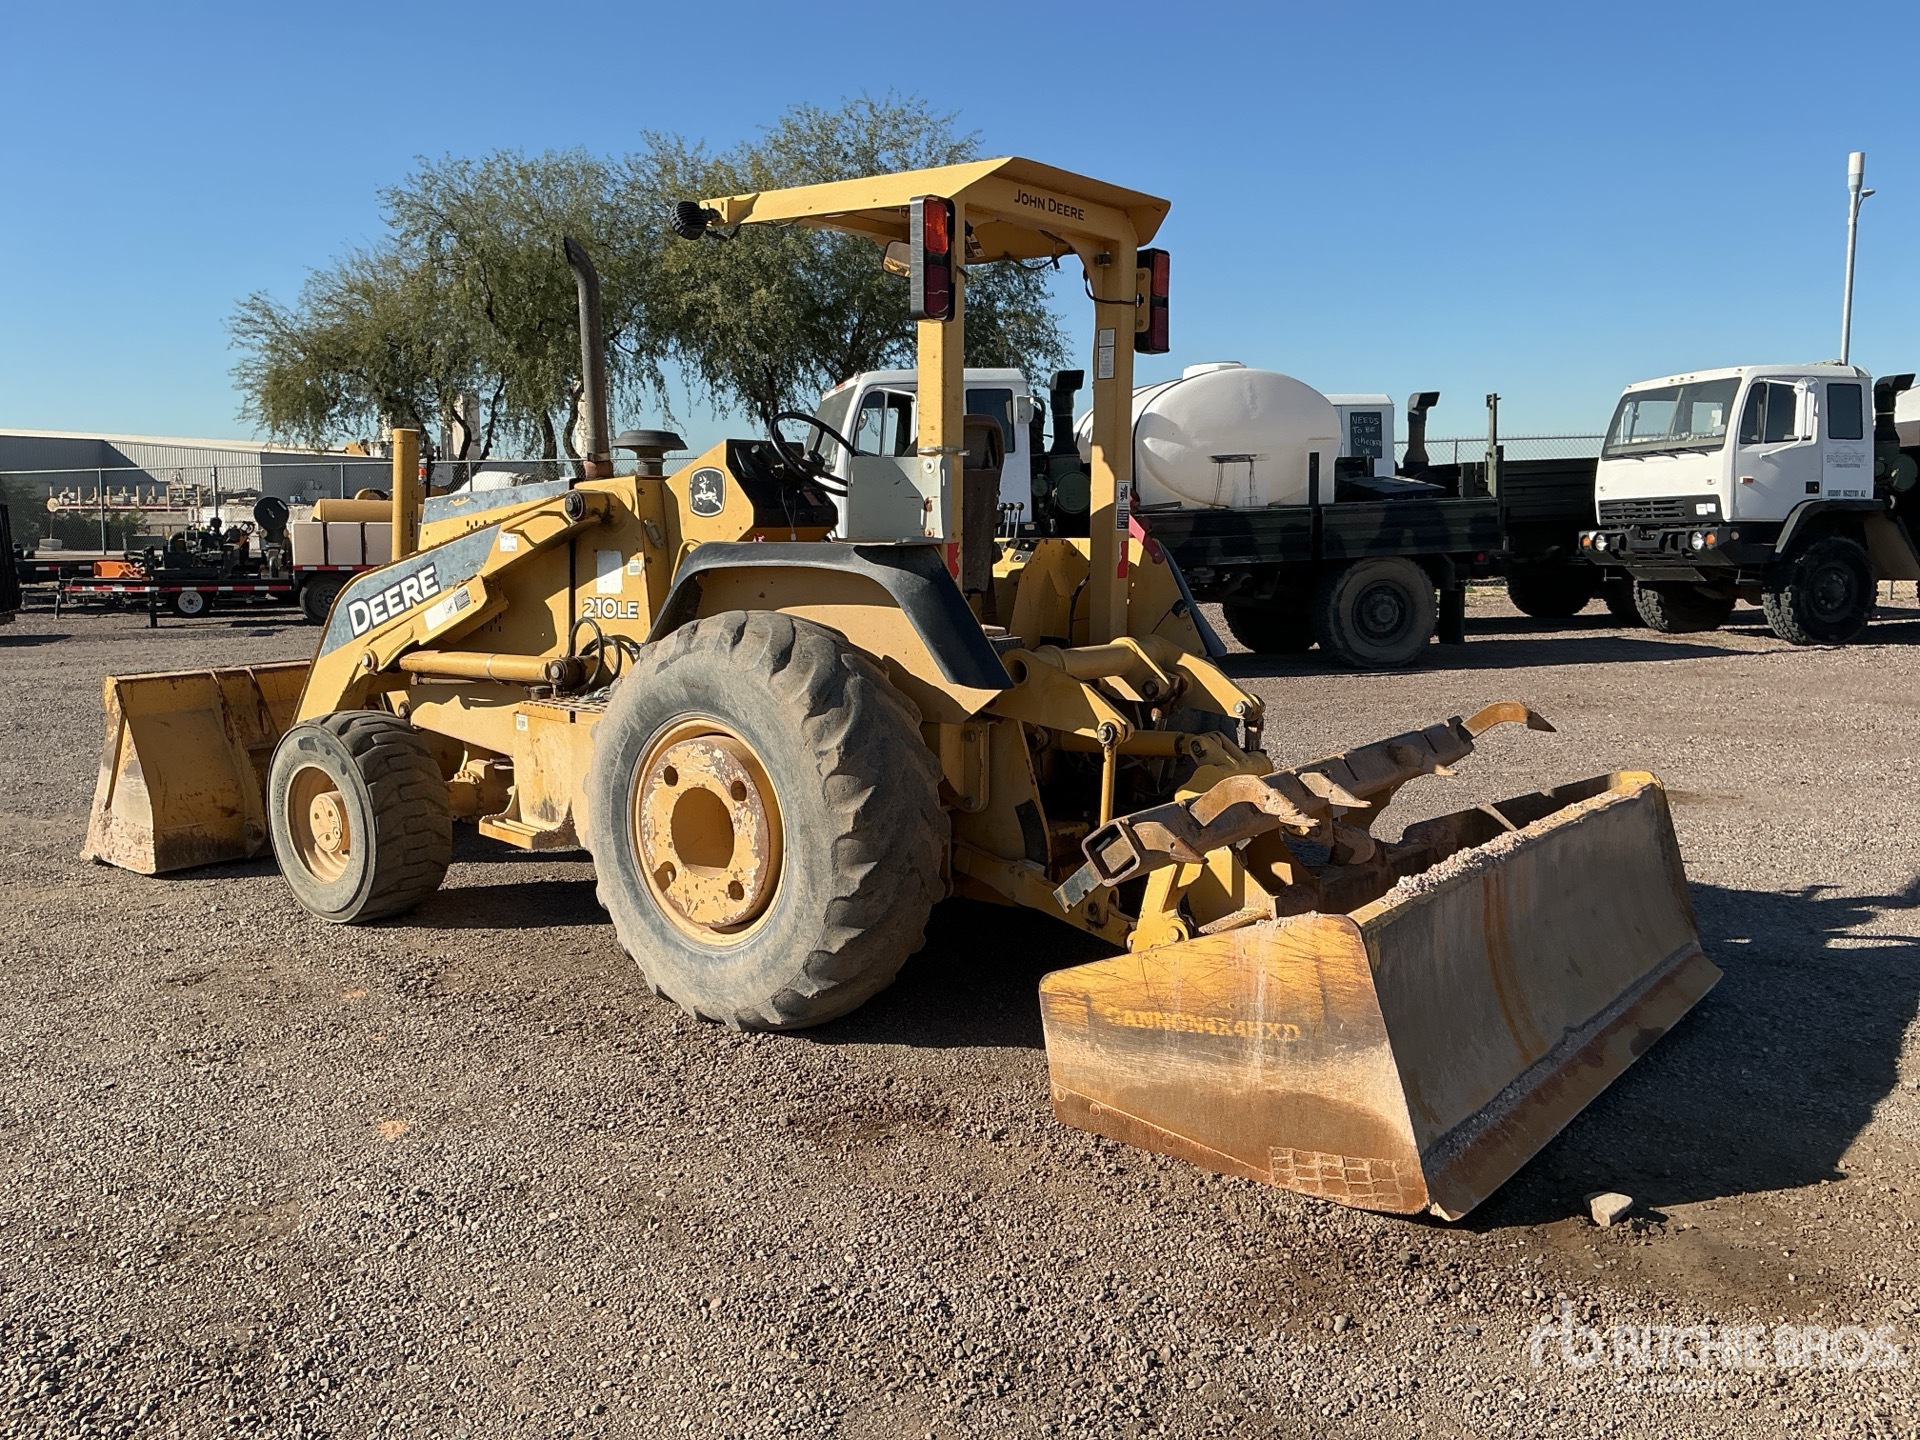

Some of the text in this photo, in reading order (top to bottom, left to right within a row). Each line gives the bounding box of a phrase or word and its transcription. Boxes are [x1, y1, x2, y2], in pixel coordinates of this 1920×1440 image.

[1014, 189, 1085, 221] JOHN DEERE
[1351, 415, 1380, 426] NEEDS
[346, 562, 441, 638] DEERE
[582, 597, 639, 619] 210LE
